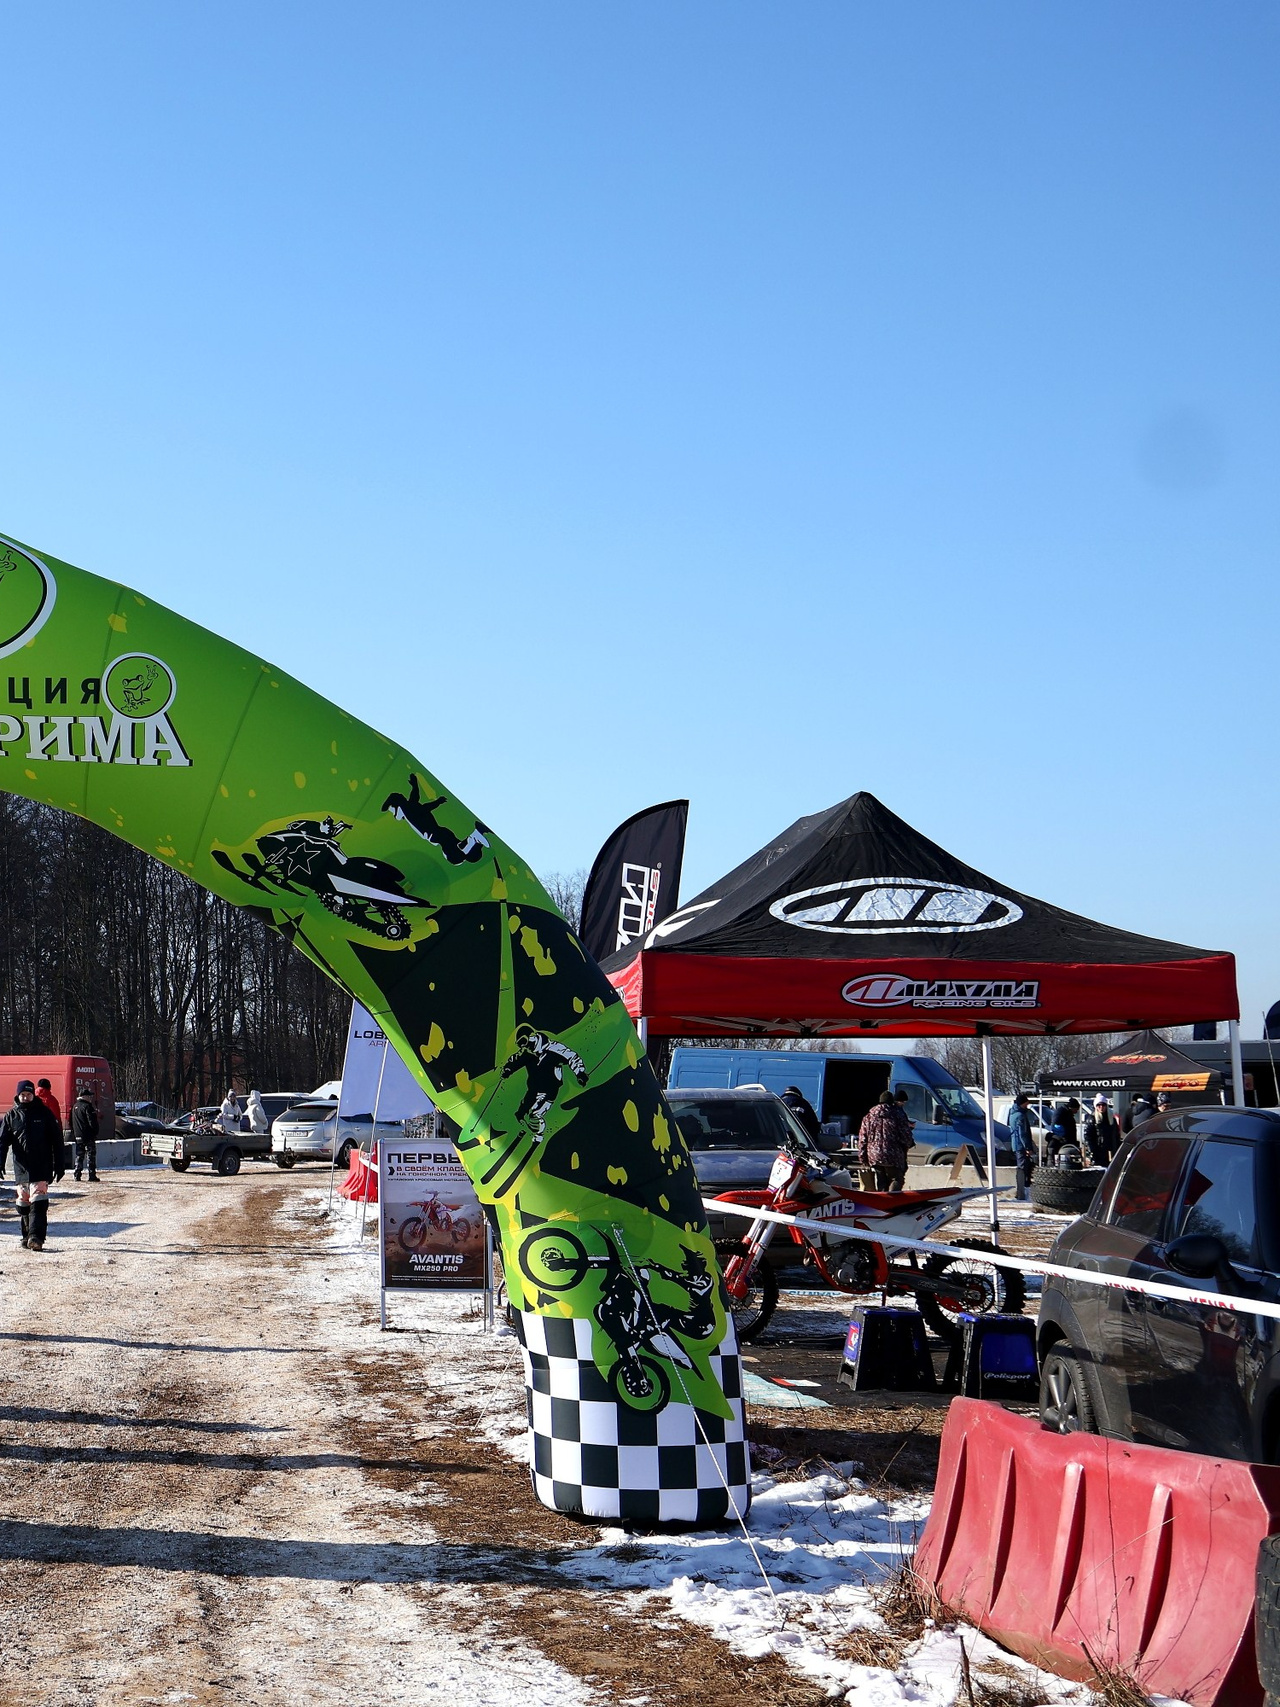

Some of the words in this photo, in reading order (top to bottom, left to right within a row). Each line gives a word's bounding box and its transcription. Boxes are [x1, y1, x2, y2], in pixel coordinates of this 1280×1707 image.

[913, 1000, 987, 1009] RACING
[989, 1000, 1036, 1008] OILS
[354, 1030, 388, 1040] LOB
[1052, 1079, 1126, 1088] WWW.KAYO.RU
[408, 1253, 464, 1265] AVANTIS
[413, 1264, 441, 1272] MX250
[442, 1264, 459, 1272] PRO
